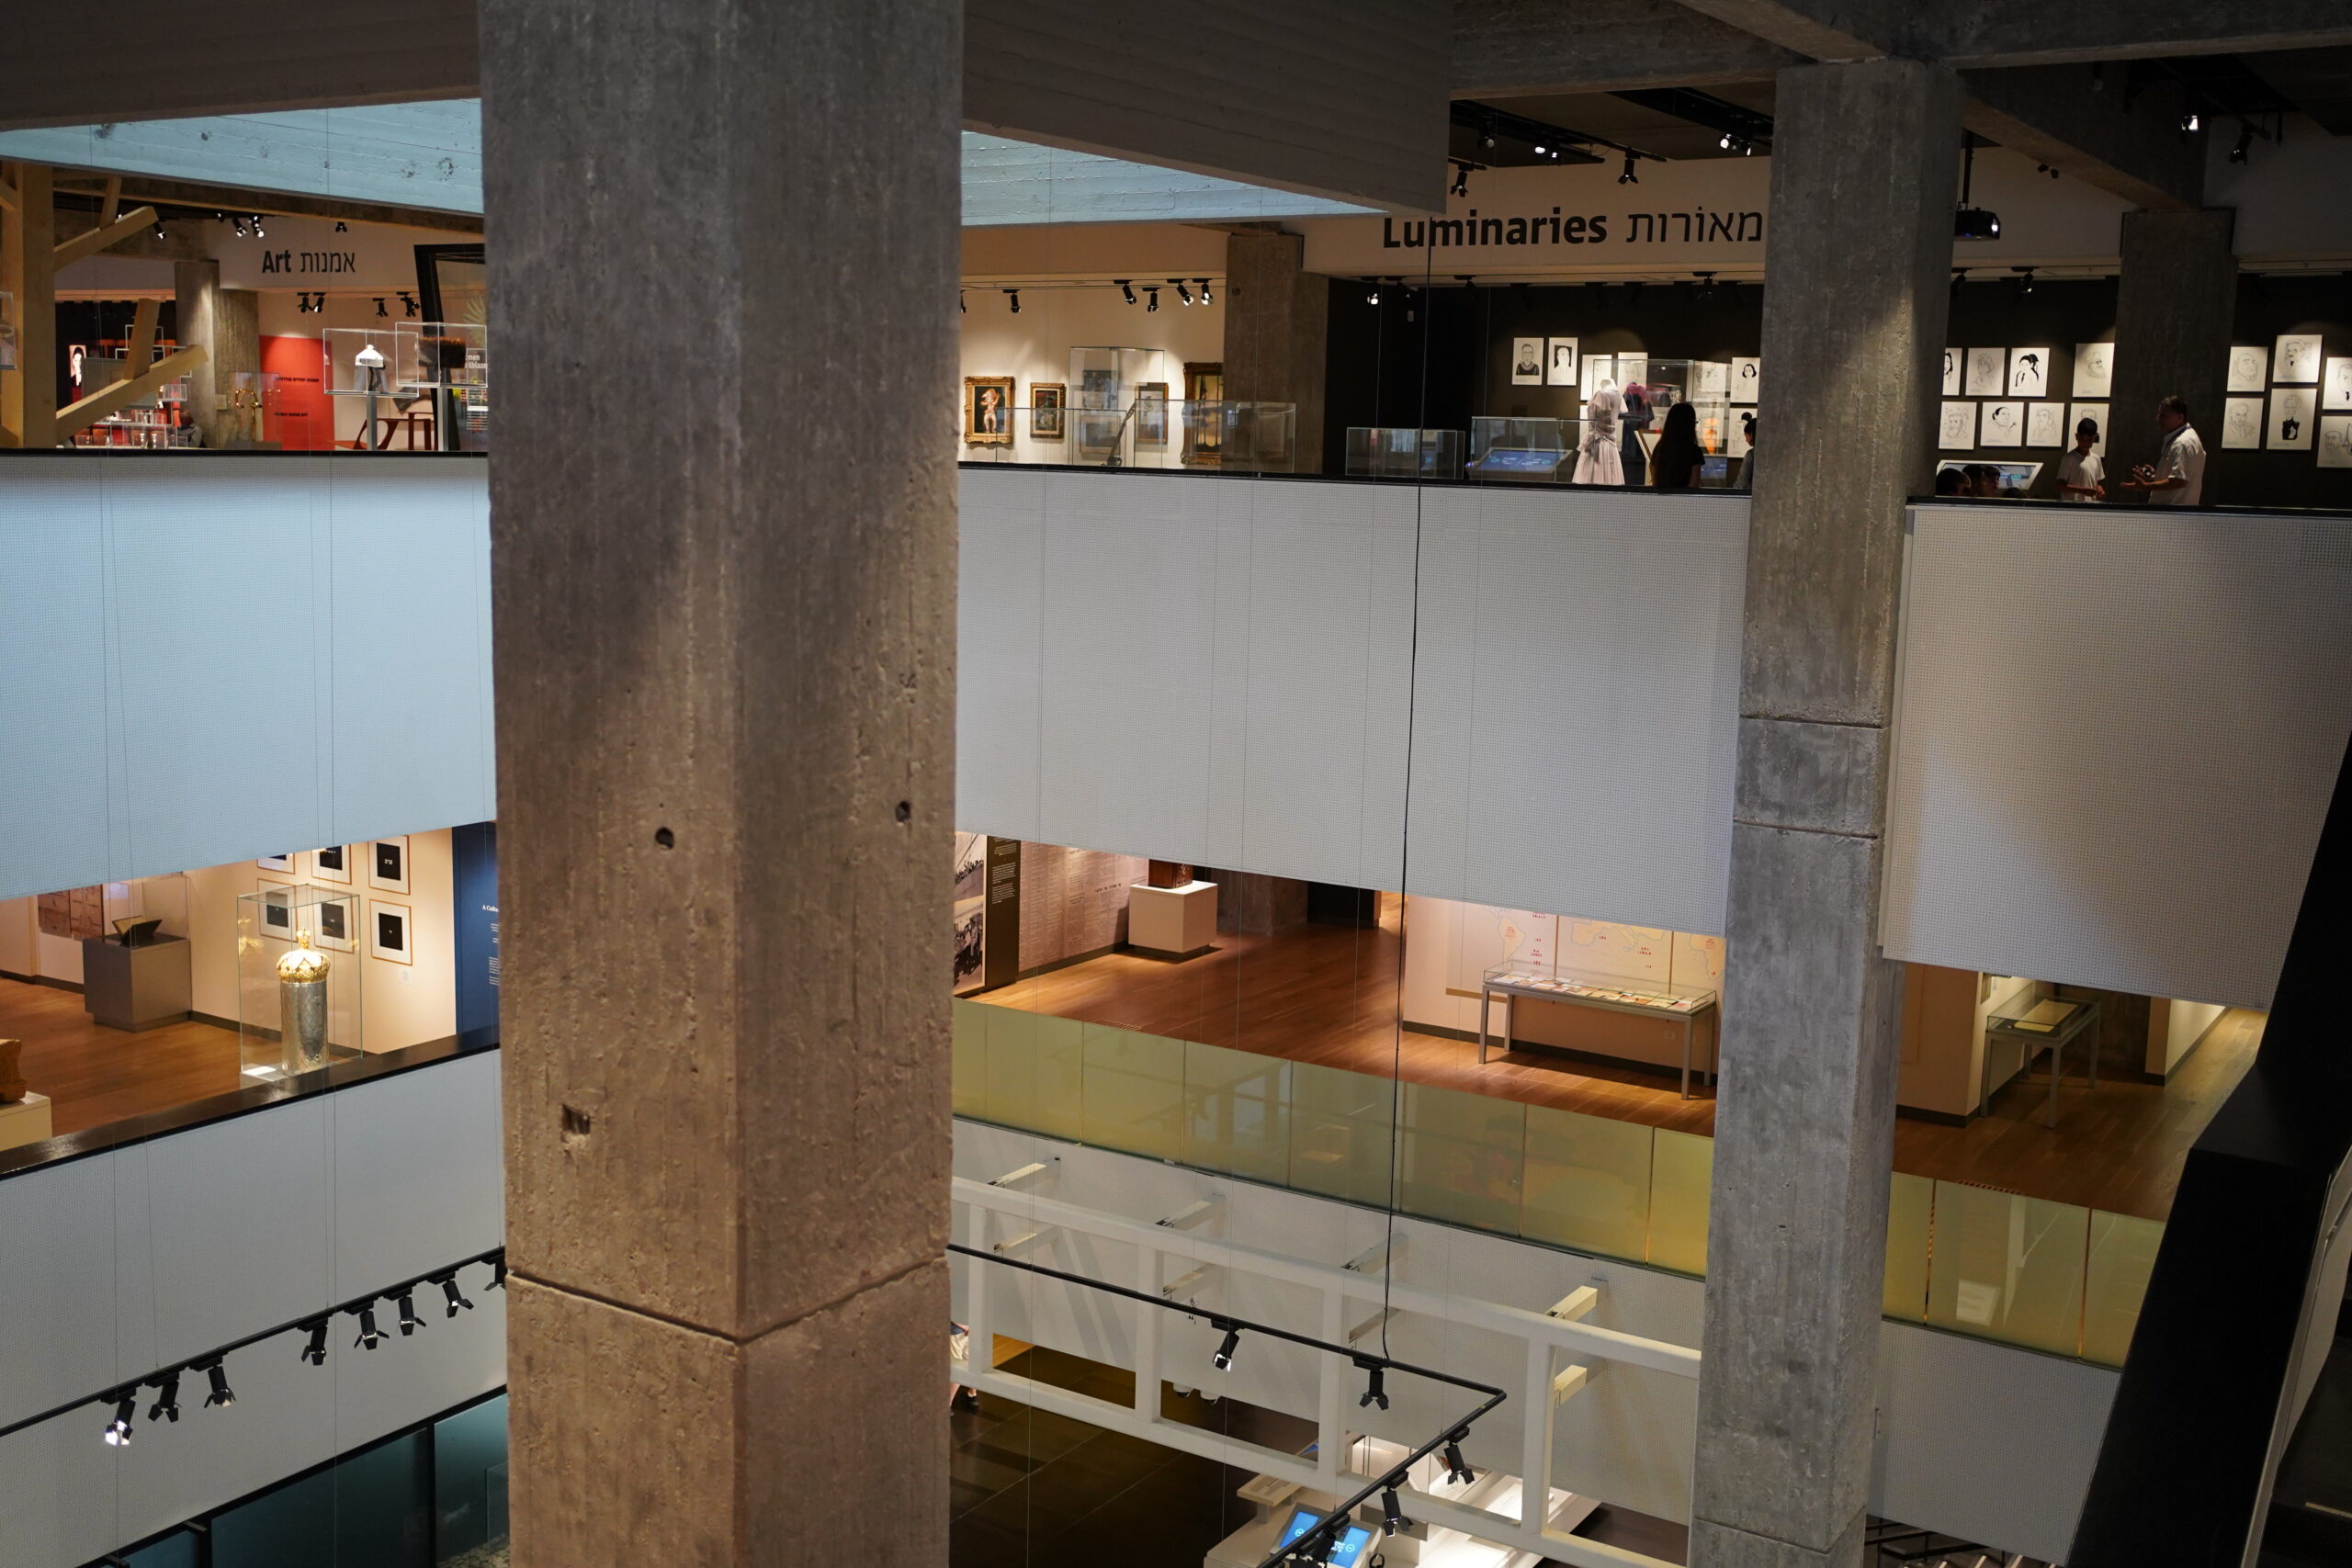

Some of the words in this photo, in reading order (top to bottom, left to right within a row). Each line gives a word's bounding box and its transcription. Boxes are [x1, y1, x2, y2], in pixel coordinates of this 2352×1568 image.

[1383, 207, 1607, 248] Luminaries
[262, 250, 291, 273] Art
[300, 252, 356, 273] אמנות
